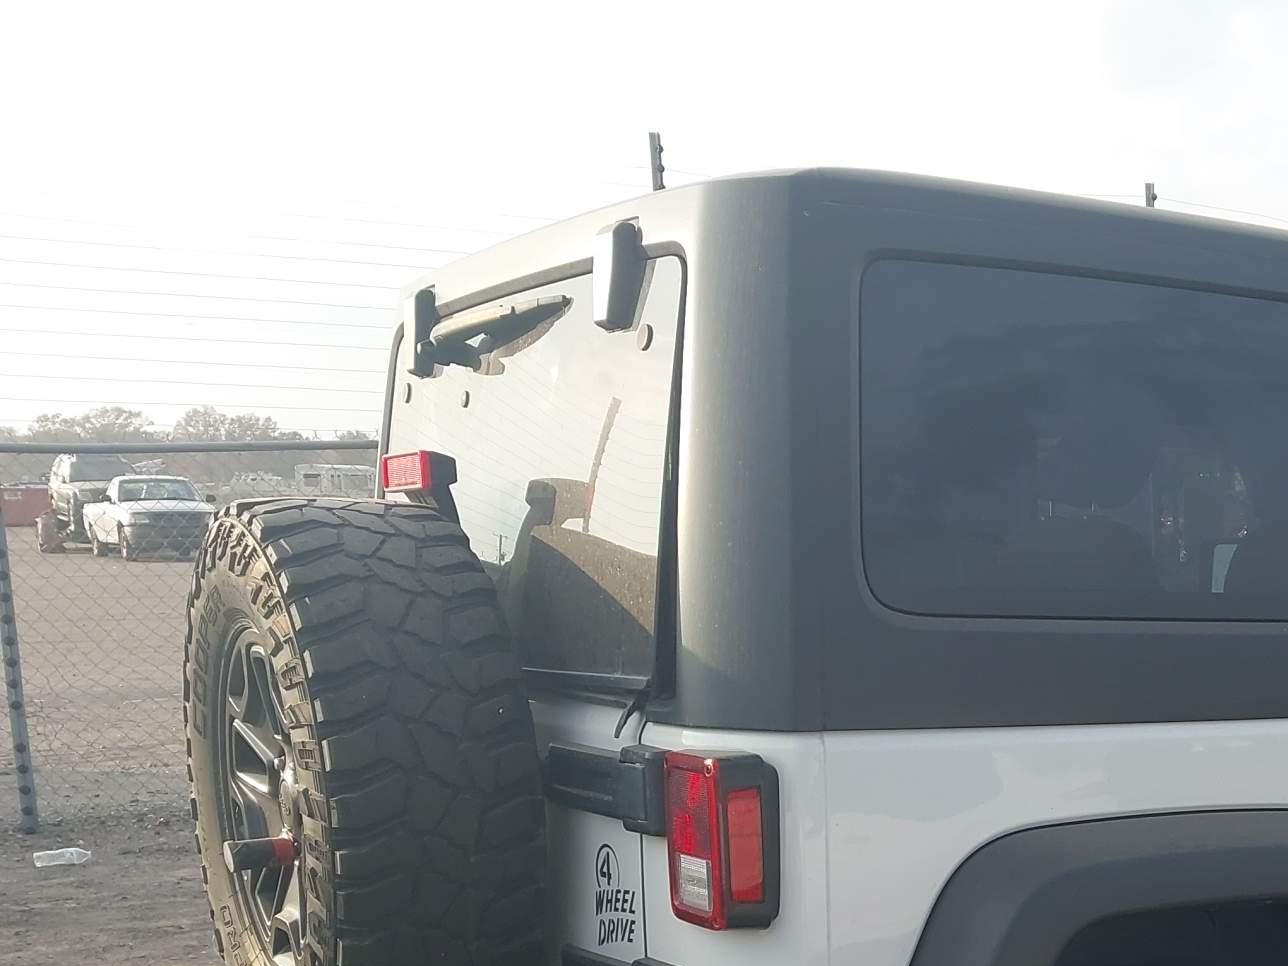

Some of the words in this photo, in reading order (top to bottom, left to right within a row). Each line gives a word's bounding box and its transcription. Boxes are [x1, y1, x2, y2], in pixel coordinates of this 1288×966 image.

[193, 584, 225, 740] COOPER
[595, 889, 636, 916] WHEEL
[598, 918, 636, 946] DRIVE
